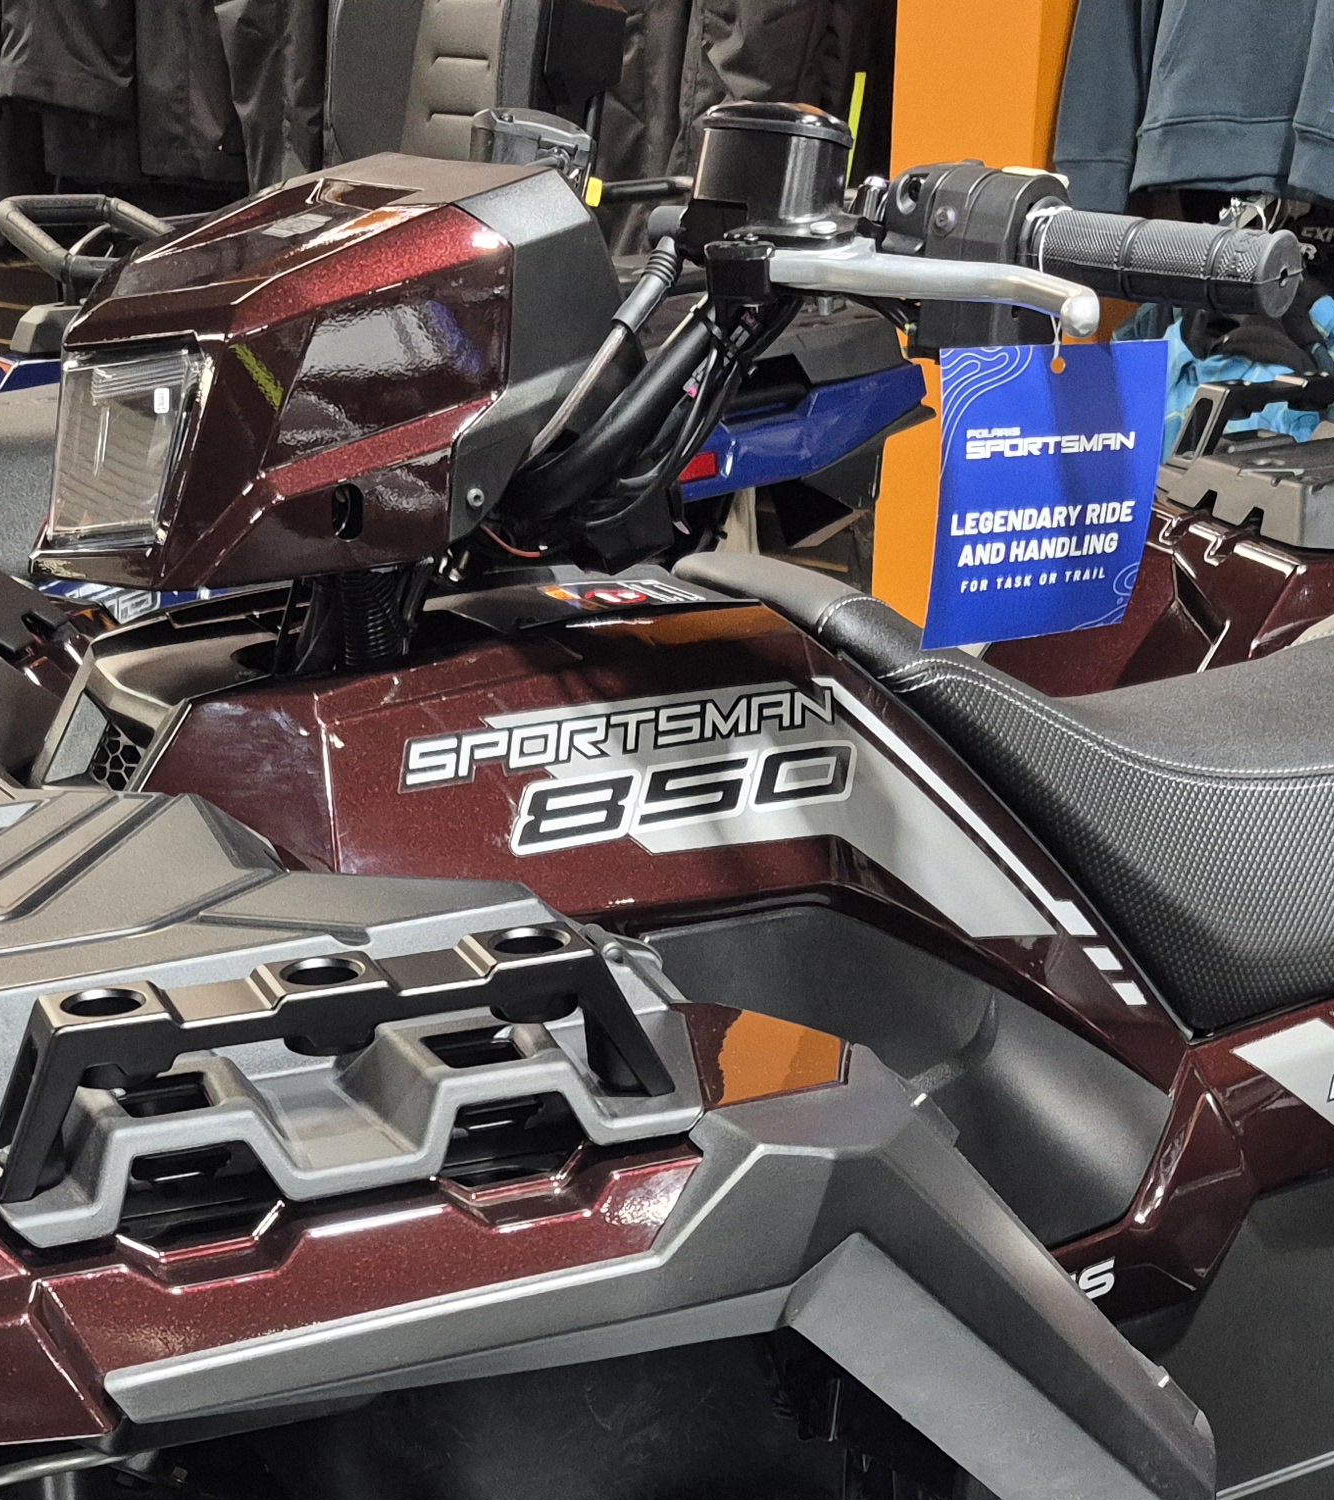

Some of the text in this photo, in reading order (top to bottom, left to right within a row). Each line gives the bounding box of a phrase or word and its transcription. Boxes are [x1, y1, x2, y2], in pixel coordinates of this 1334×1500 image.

[965, 431, 1136, 460] SPORTSMAN
[966, 426, 1021, 439] POLARIS
[950, 500, 1136, 536] LEGENDARY RIDE
[957, 532, 1119, 567] AND HANDLING
[960, 566, 1106, 593] FOR TASK OR TRAIL
[405, 689, 835, 786] SPORTSMAN
[509, 740, 857, 857] 850
